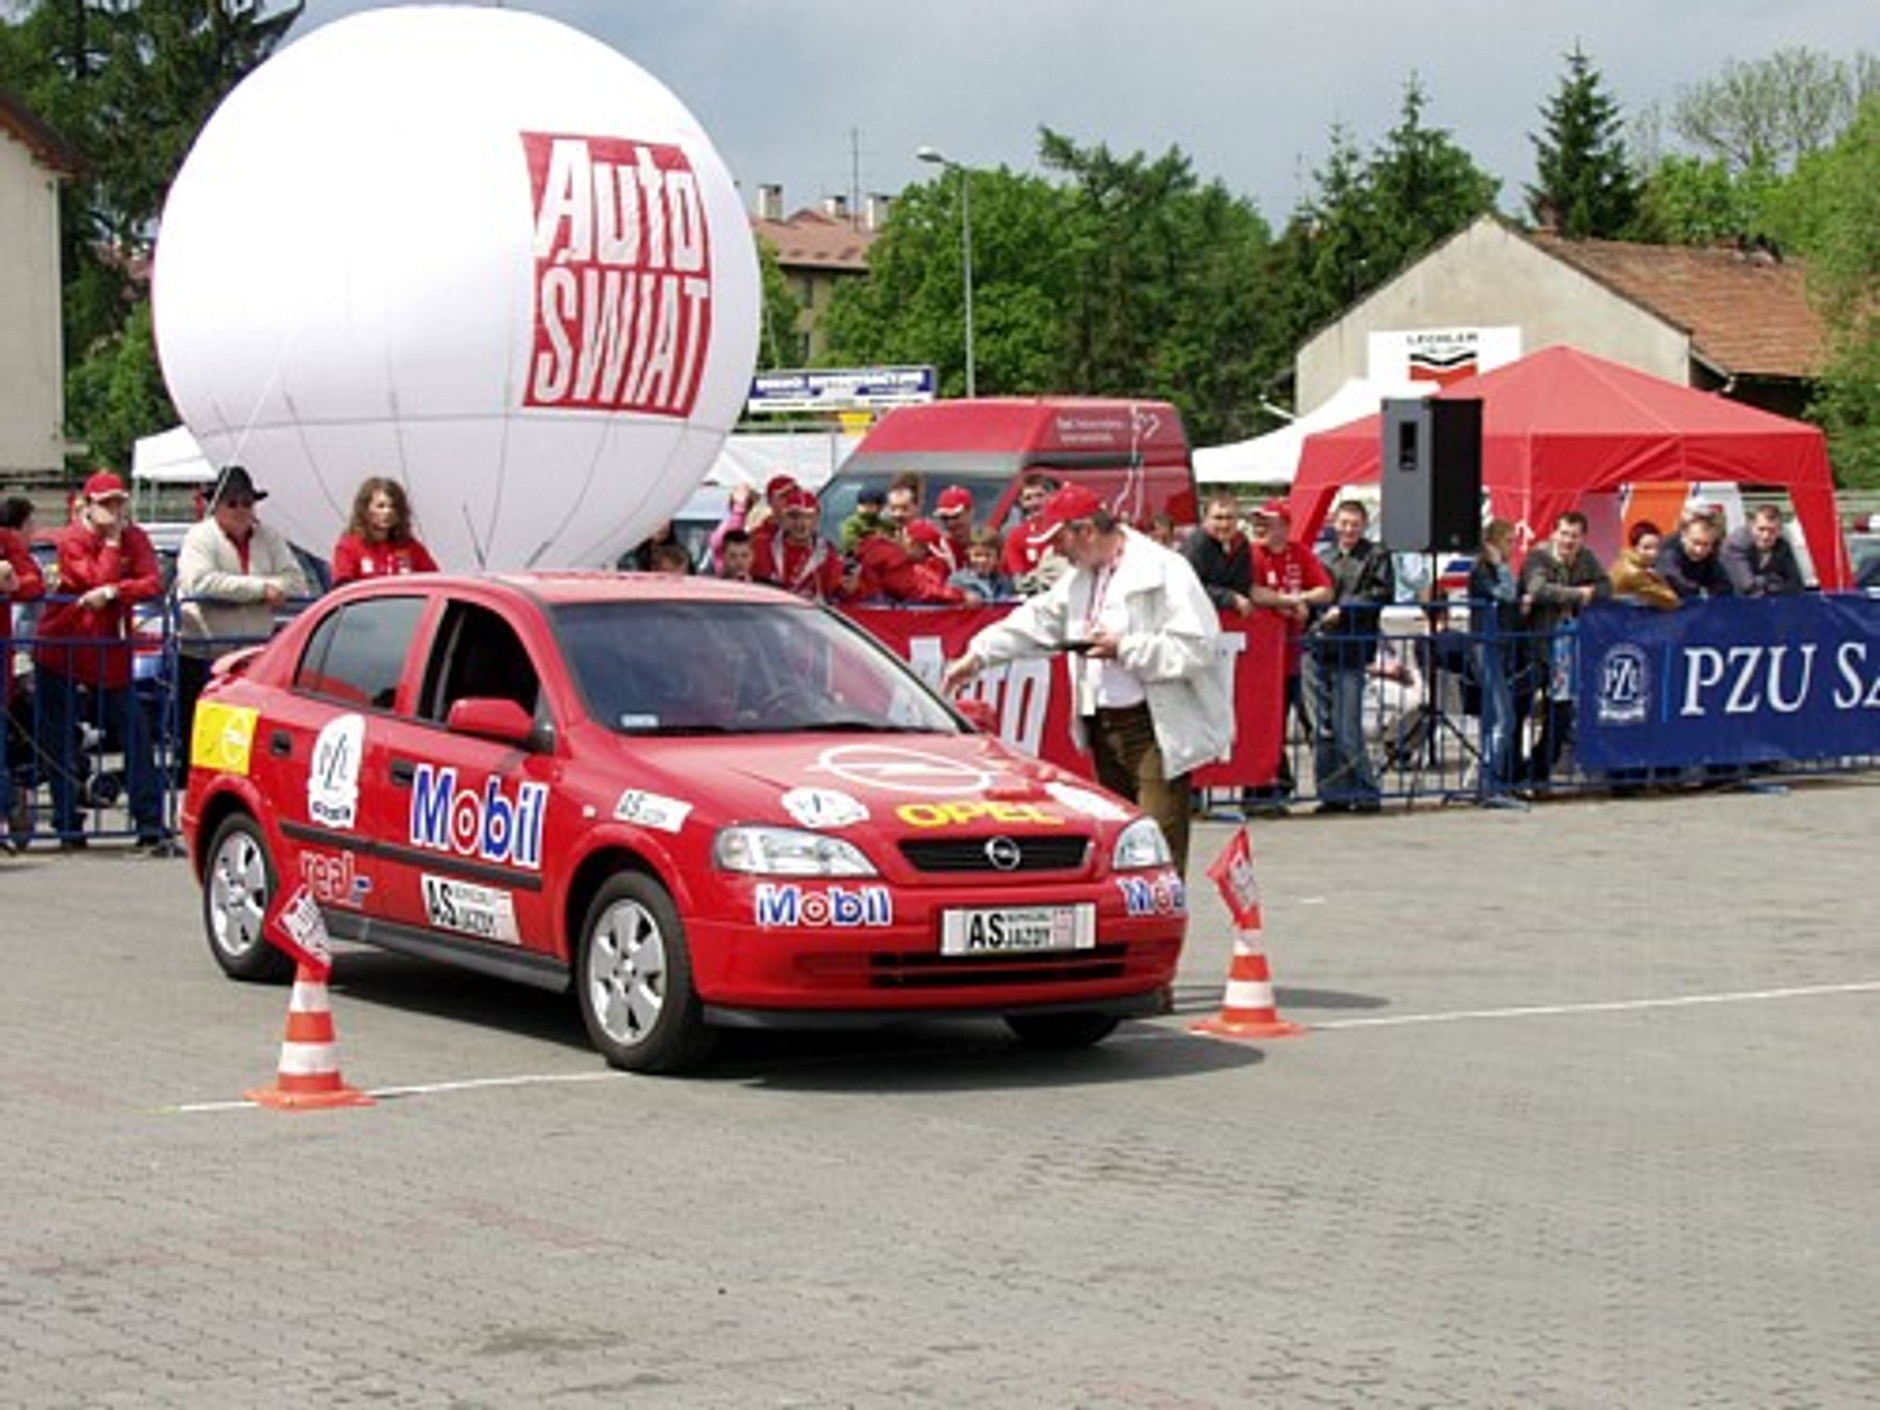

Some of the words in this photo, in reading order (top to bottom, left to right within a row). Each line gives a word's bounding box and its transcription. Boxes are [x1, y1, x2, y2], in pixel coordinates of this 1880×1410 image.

[1681, 643, 1817, 716] PZU
[411, 764, 548, 869] Mobil
[896, 802, 1065, 827] OPEL
[755, 883, 893, 926] Mobil
[969, 912, 1005, 948] AS
